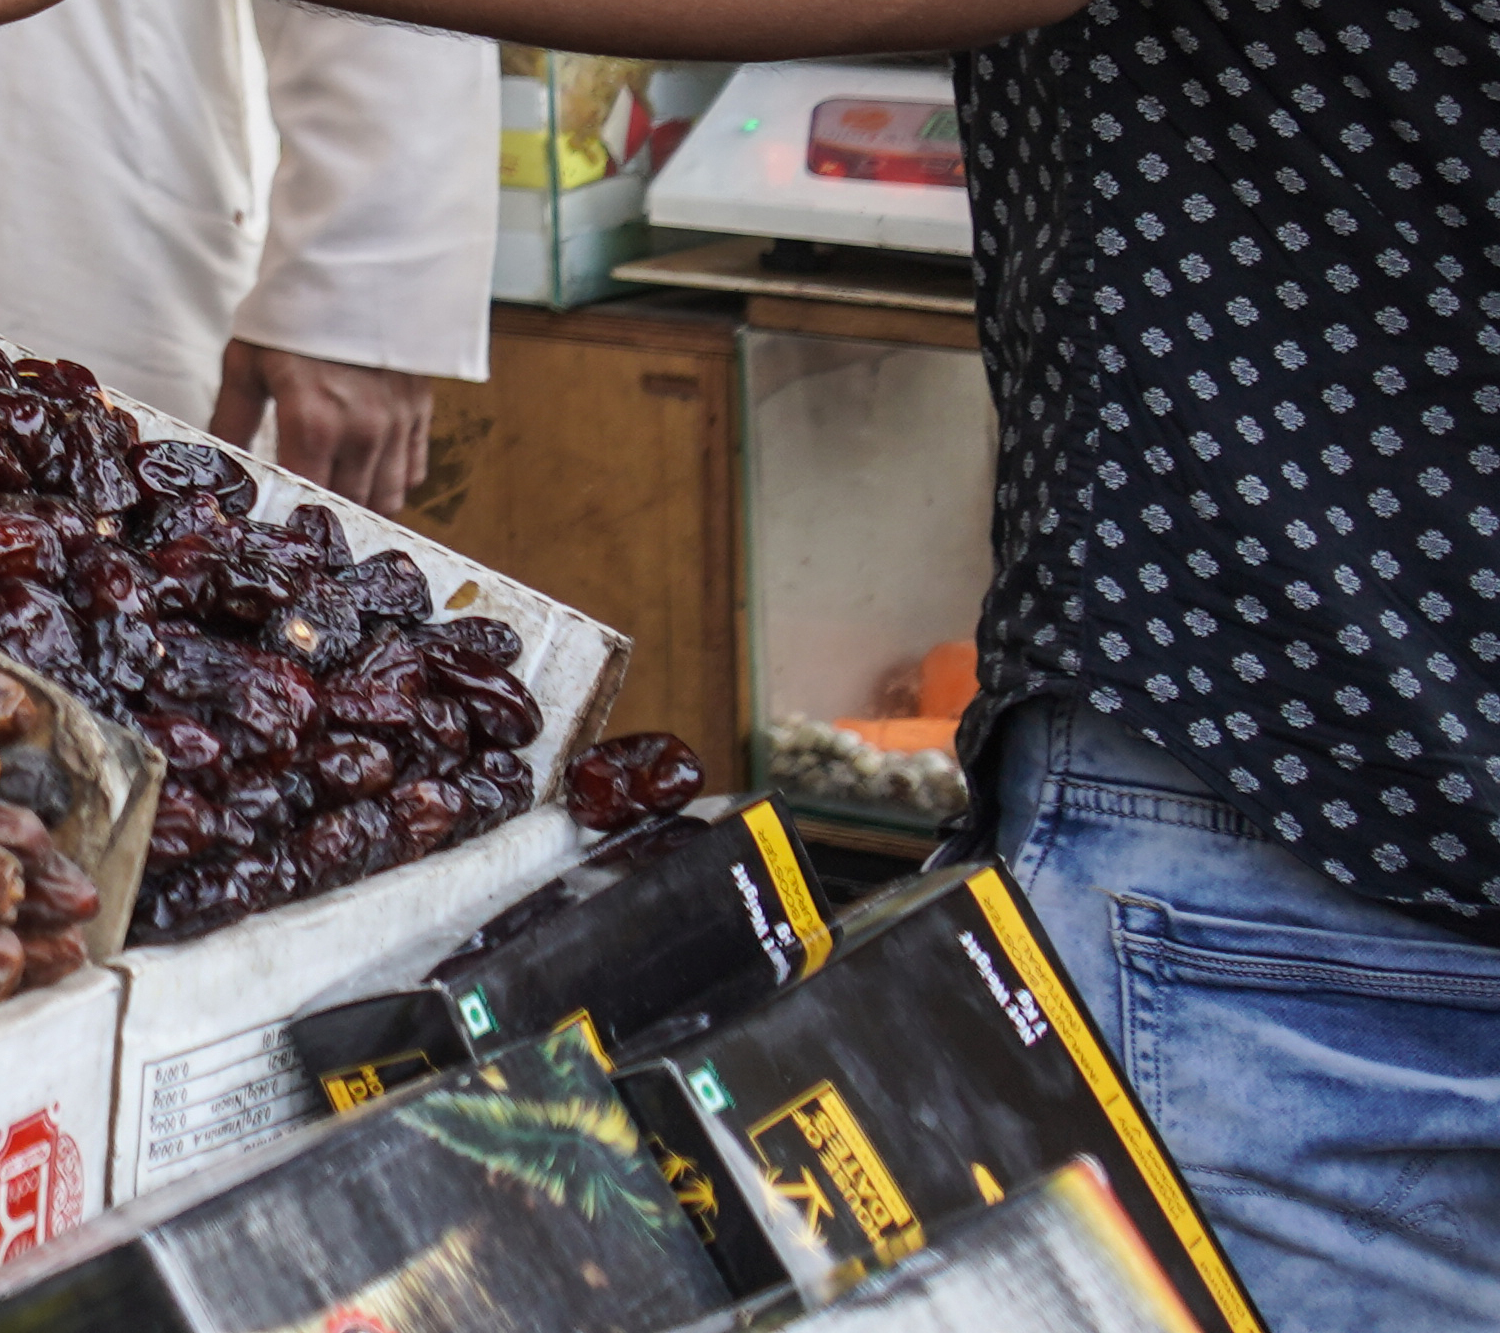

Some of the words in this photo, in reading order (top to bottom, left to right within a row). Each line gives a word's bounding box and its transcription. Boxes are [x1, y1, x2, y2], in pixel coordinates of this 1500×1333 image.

[729, 861, 770, 940] Weight
[757, 828, 801, 922] BOOSTER
[957, 929, 1011, 1008] Weight
[982, 895, 1041, 989] BOOSTER
[1016, 933, 1082, 1033] (NATURAL)
[1005, 1001, 1037, 1047] Net
[1014, 988, 1040, 1023] Kg
[1032, 1019, 1048, 1038] 1
[1039, 991, 1100, 1087] IMMUNITY
[789, 1107, 824, 1150] OF
[812, 1109, 893, 1229] DATES
[817, 1149, 887, 1247] HOUSE
